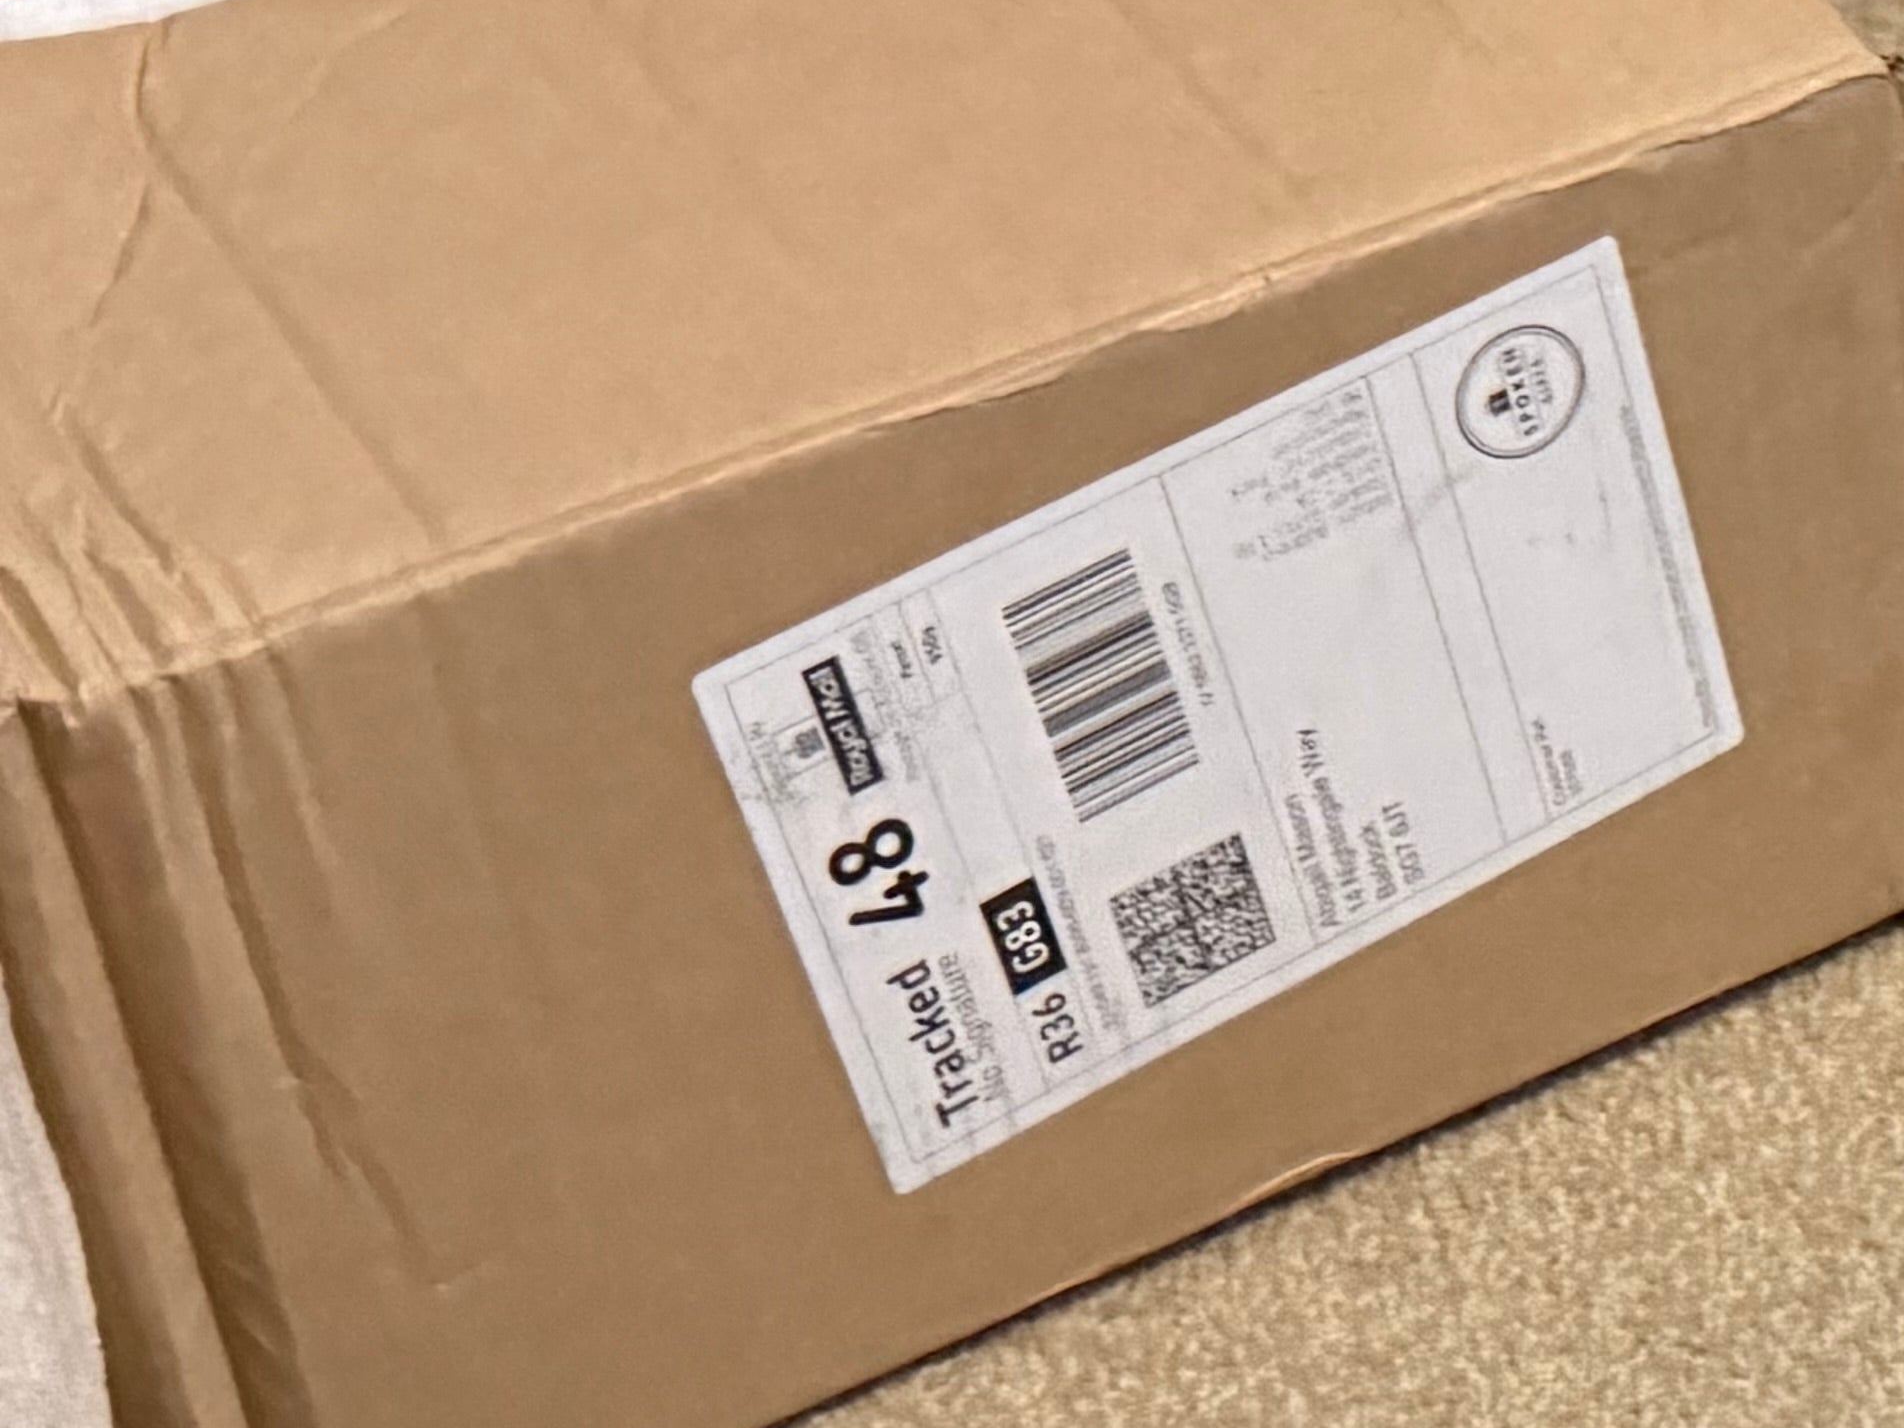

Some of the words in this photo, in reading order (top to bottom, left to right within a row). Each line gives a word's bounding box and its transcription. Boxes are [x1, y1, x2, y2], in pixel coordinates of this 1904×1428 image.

[807, 664, 849, 723] Mail
[827, 713, 879, 789] Royal
[828, 817, 930, 927] 48
[996, 899, 1051, 975] G83
[886, 960, 974, 1127] Tracked
[1032, 991, 1083, 1064] R36
